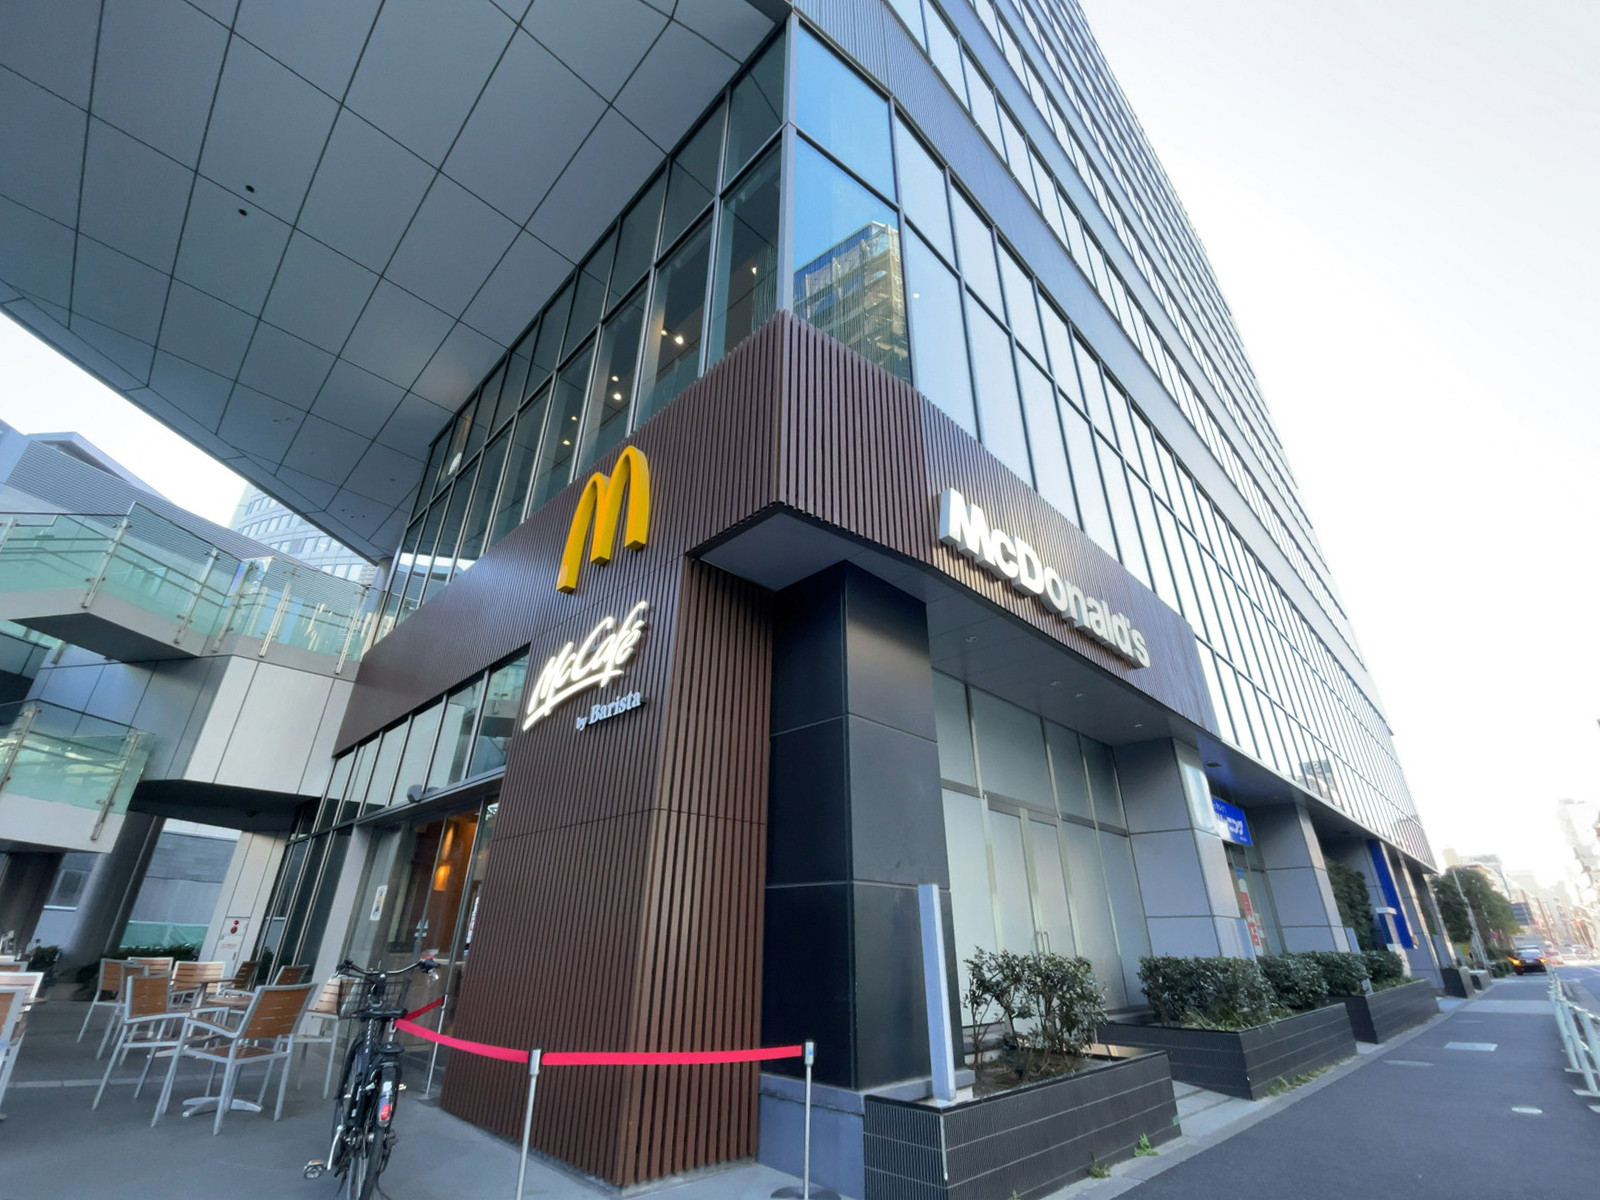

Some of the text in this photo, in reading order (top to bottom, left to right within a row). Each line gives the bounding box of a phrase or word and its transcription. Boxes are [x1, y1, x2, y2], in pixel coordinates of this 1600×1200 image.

[939, 487, 1150, 669] McDonald's
[523, 601, 649, 731] McCafé
[576, 690, 641, 731] by Barista
